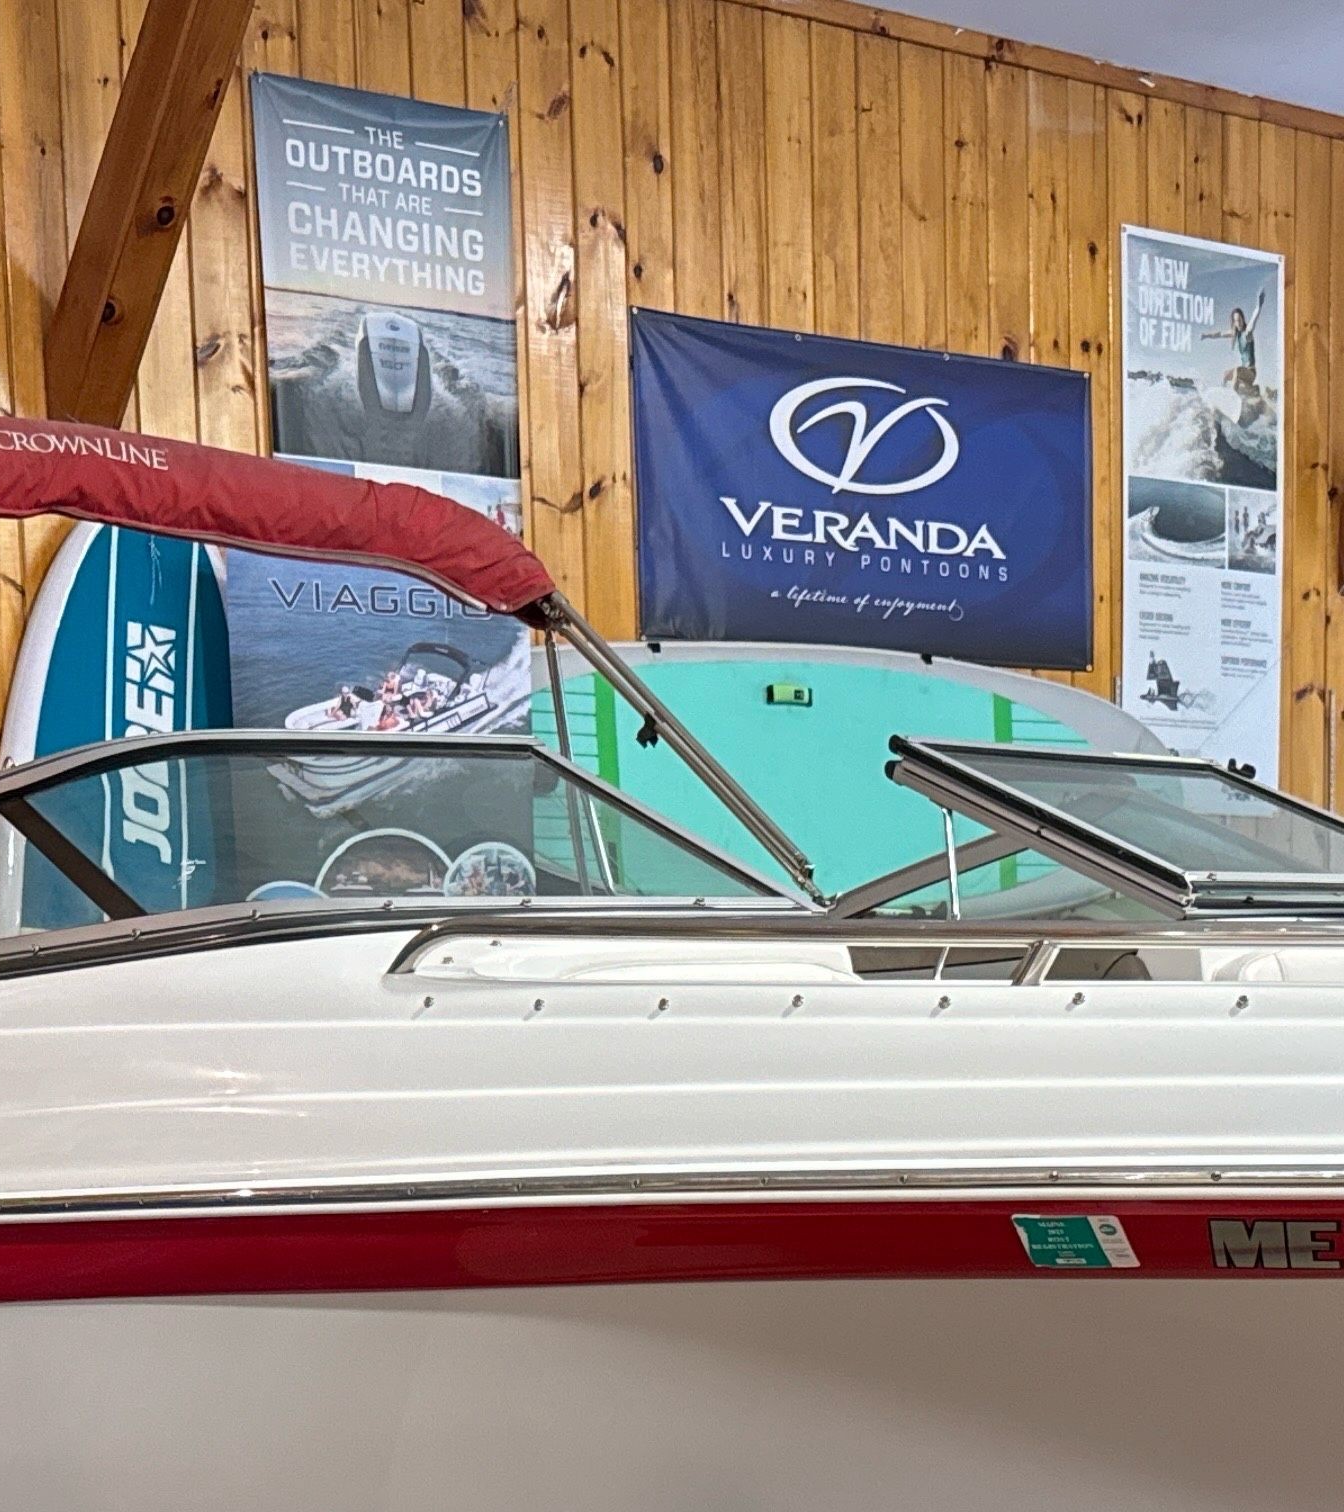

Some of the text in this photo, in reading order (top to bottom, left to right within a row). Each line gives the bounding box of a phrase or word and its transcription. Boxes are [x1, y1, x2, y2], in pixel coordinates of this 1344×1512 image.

[364, 126, 404, 150] THE
[284, 137, 483, 198] OUTBOARDS
[338, 182, 432, 215] THAT ARE
[287, 200, 485, 264] CHANGING
[290, 242, 485, 297] EVERYTHING
[1139, 253, 1190, 289] A NEW
[1138, 285, 1214, 326] DIRECTION
[1140, 319, 1193, 353] OF FUN
[720, 496, 1007, 560] VERANDA
[721, 541, 1009, 582] LUXURY PONTOONS
[770, 585, 964, 622] a lifetime of enjoyment
